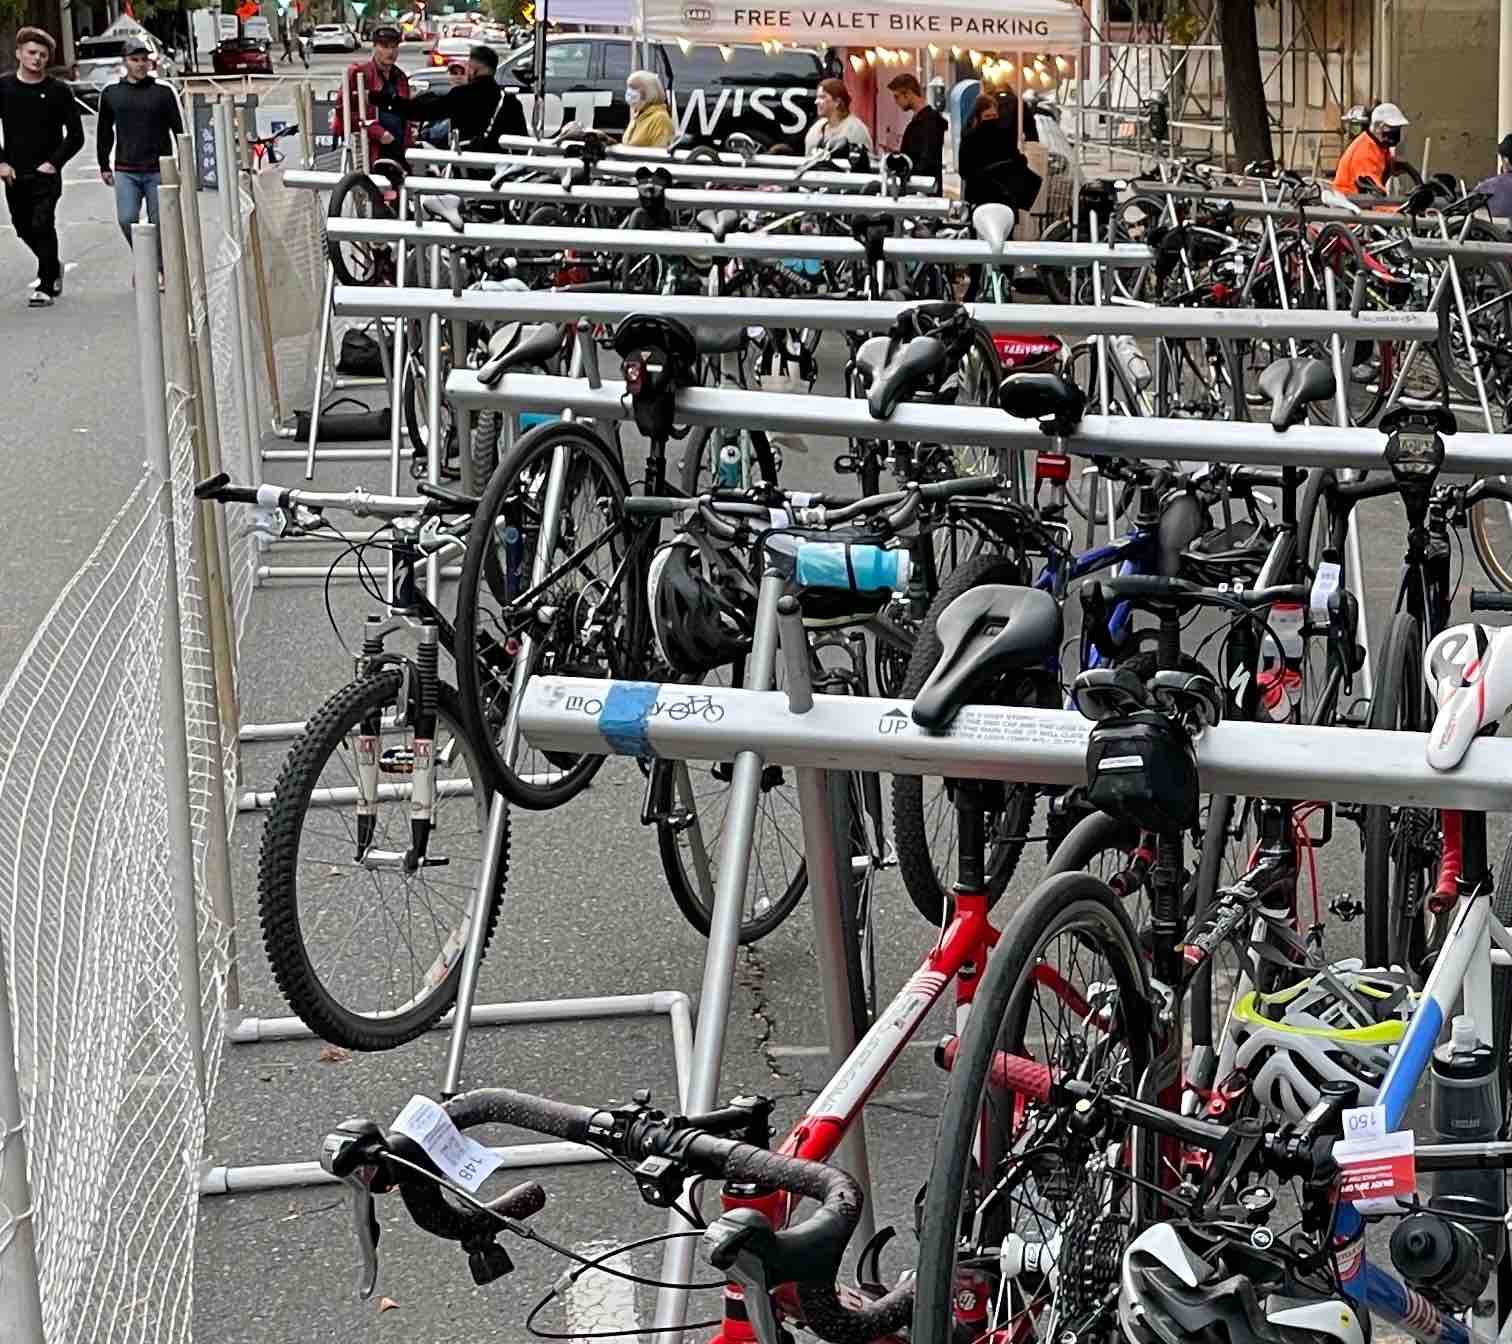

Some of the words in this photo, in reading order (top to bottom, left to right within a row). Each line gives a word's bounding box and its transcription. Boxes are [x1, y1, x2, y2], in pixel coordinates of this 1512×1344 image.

[734, 9, 792, 27] FREE
[801, 12, 880, 30] VALET
[889, 15, 941, 32] BIKE
[951, 17, 1049, 37] PARKING
[666, 86, 809, 136] WISS
[878, 719, 908, 735] UP
